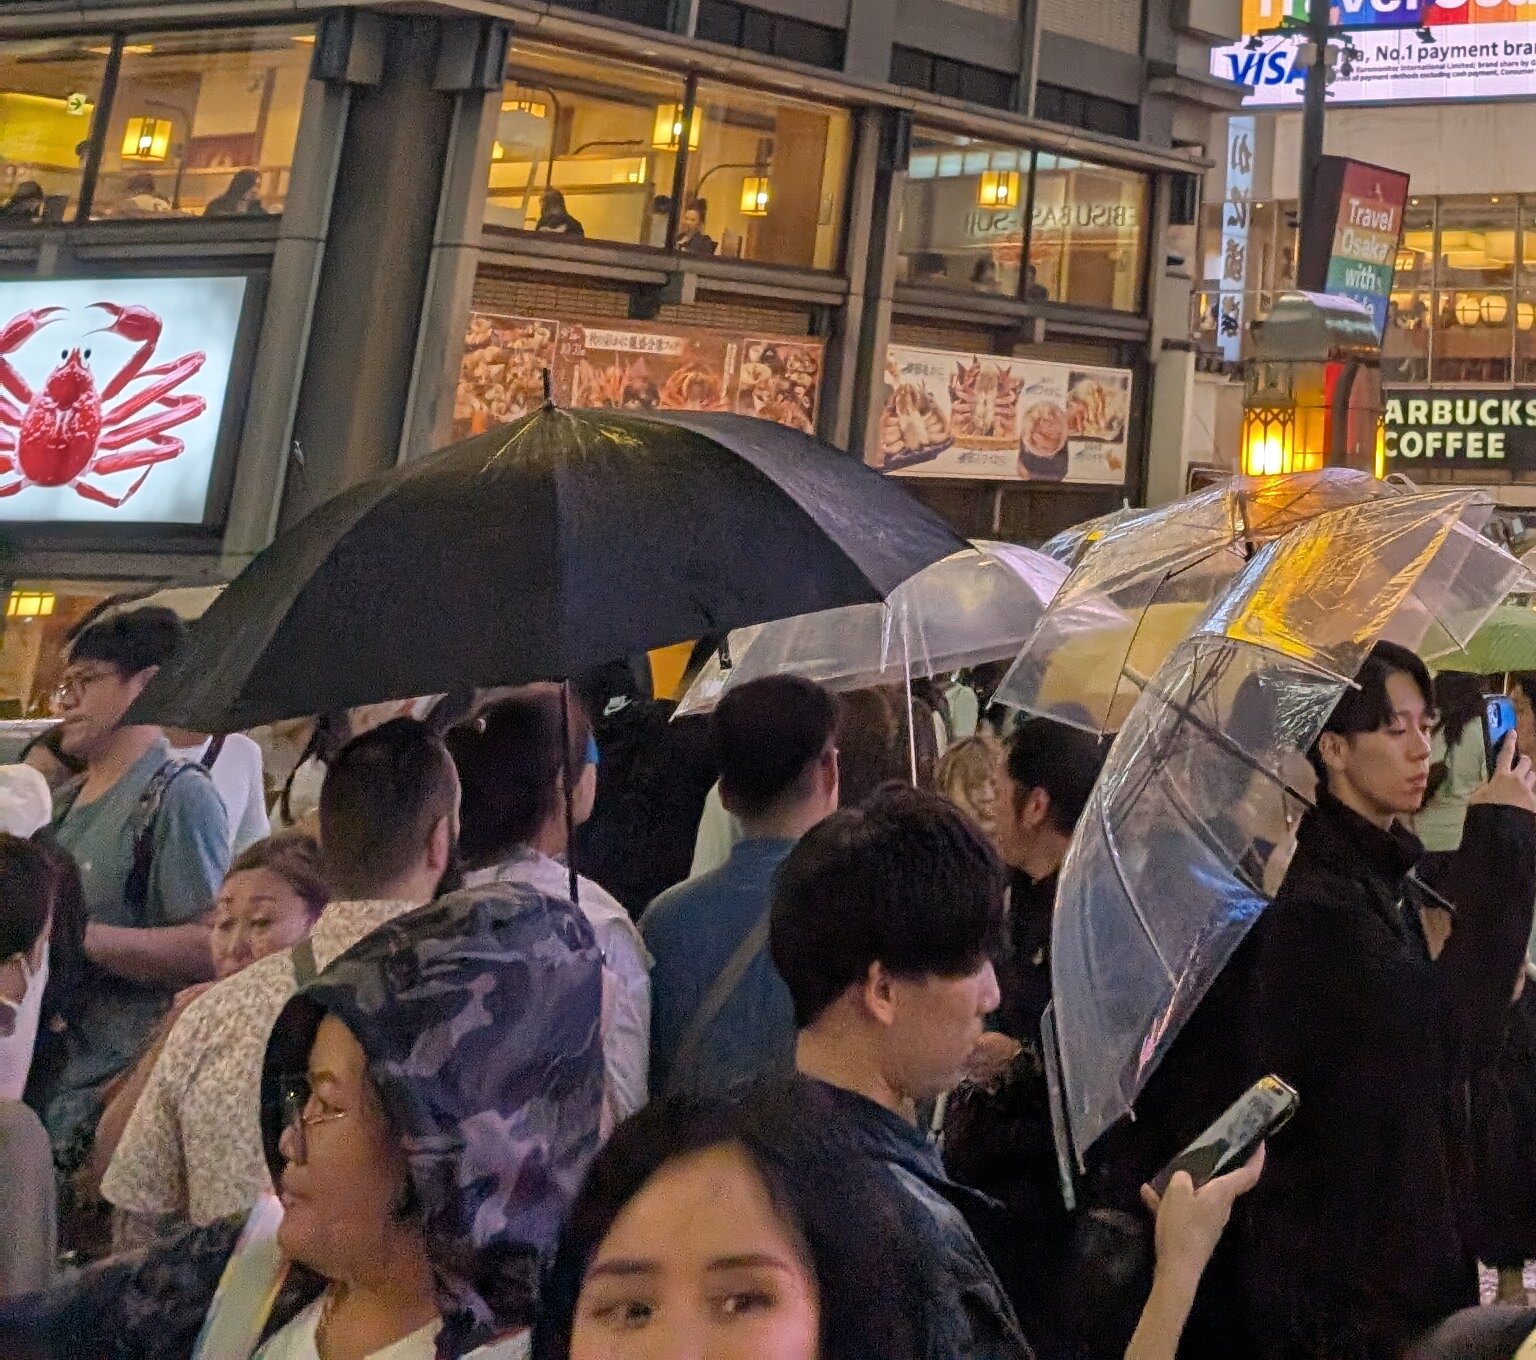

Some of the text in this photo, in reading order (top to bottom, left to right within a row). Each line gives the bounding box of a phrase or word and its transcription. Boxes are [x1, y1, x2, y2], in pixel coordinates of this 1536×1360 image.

[1375, 46, 1414, 62] No.1
[1417, 42, 1498, 65] payment
[1349, 198, 1395, 231] Travel
[1341, 232, 1389, 261] Osaka
[1346, 264, 1378, 290] with
